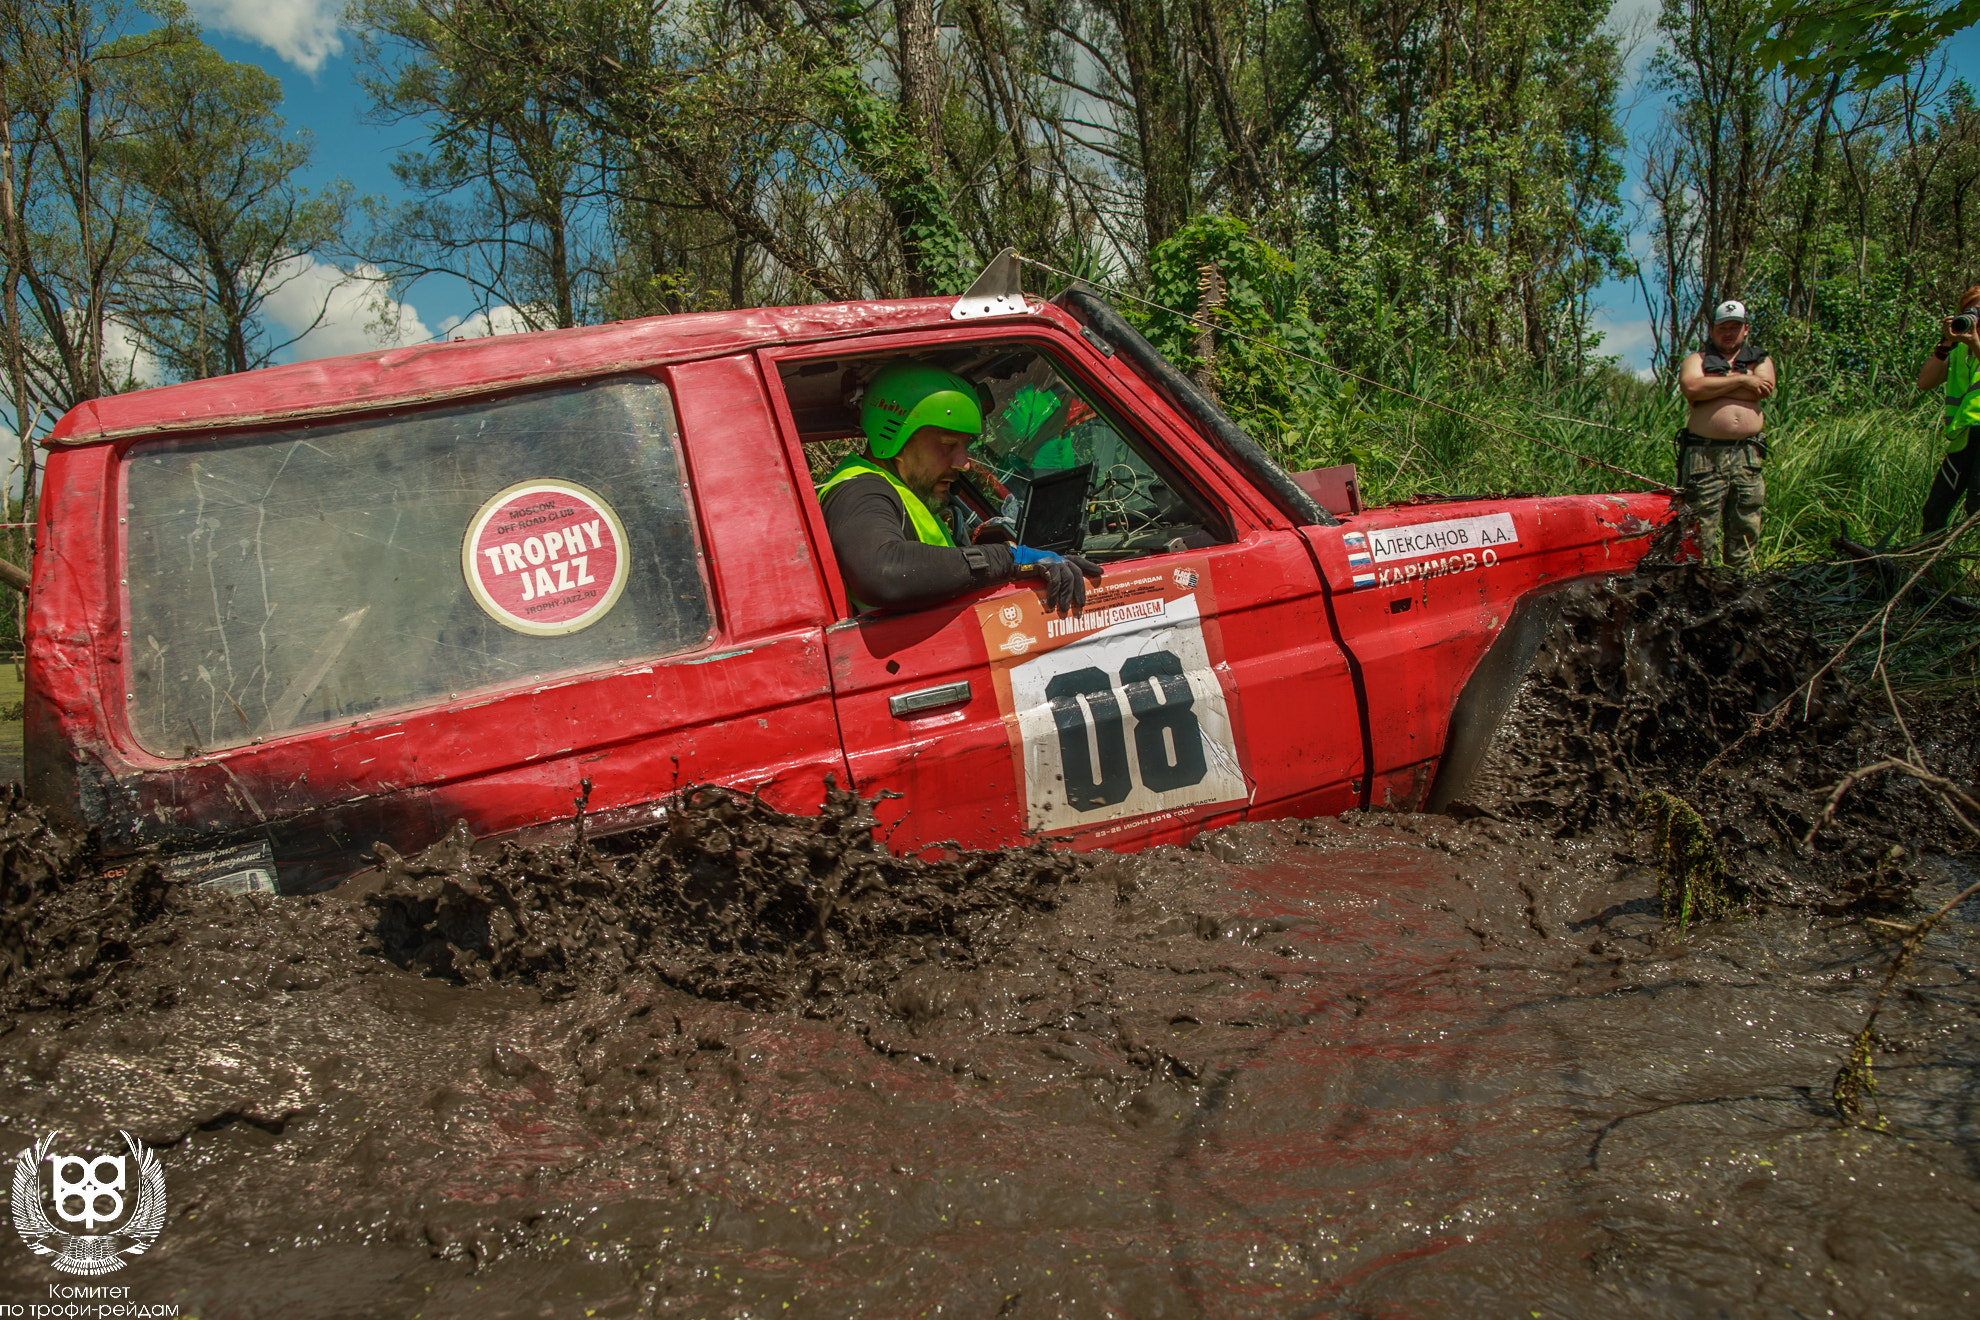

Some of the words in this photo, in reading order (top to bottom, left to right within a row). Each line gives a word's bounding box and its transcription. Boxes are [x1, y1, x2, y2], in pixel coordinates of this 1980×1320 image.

[497, 524, 517, 535] OFF
[518, 515, 547, 530] ROAD
[548, 507, 575, 522] CLUB
[509, 500, 555, 520] MOSCOW
[484, 519, 602, 576] TROPHY
[520, 555, 595, 601] JAZZ
[1105, 575, 1163, 591] ТРОФИ-РЕЙДАМ
[524, 589, 597, 615] TROPHY-JAZZ.RU
[1047, 609, 1111, 638] УТОМЛЕННЫЕ
[1111, 601, 1162, 622] СОЛНЦЕМ
[1045, 650, 1208, 812] 08
